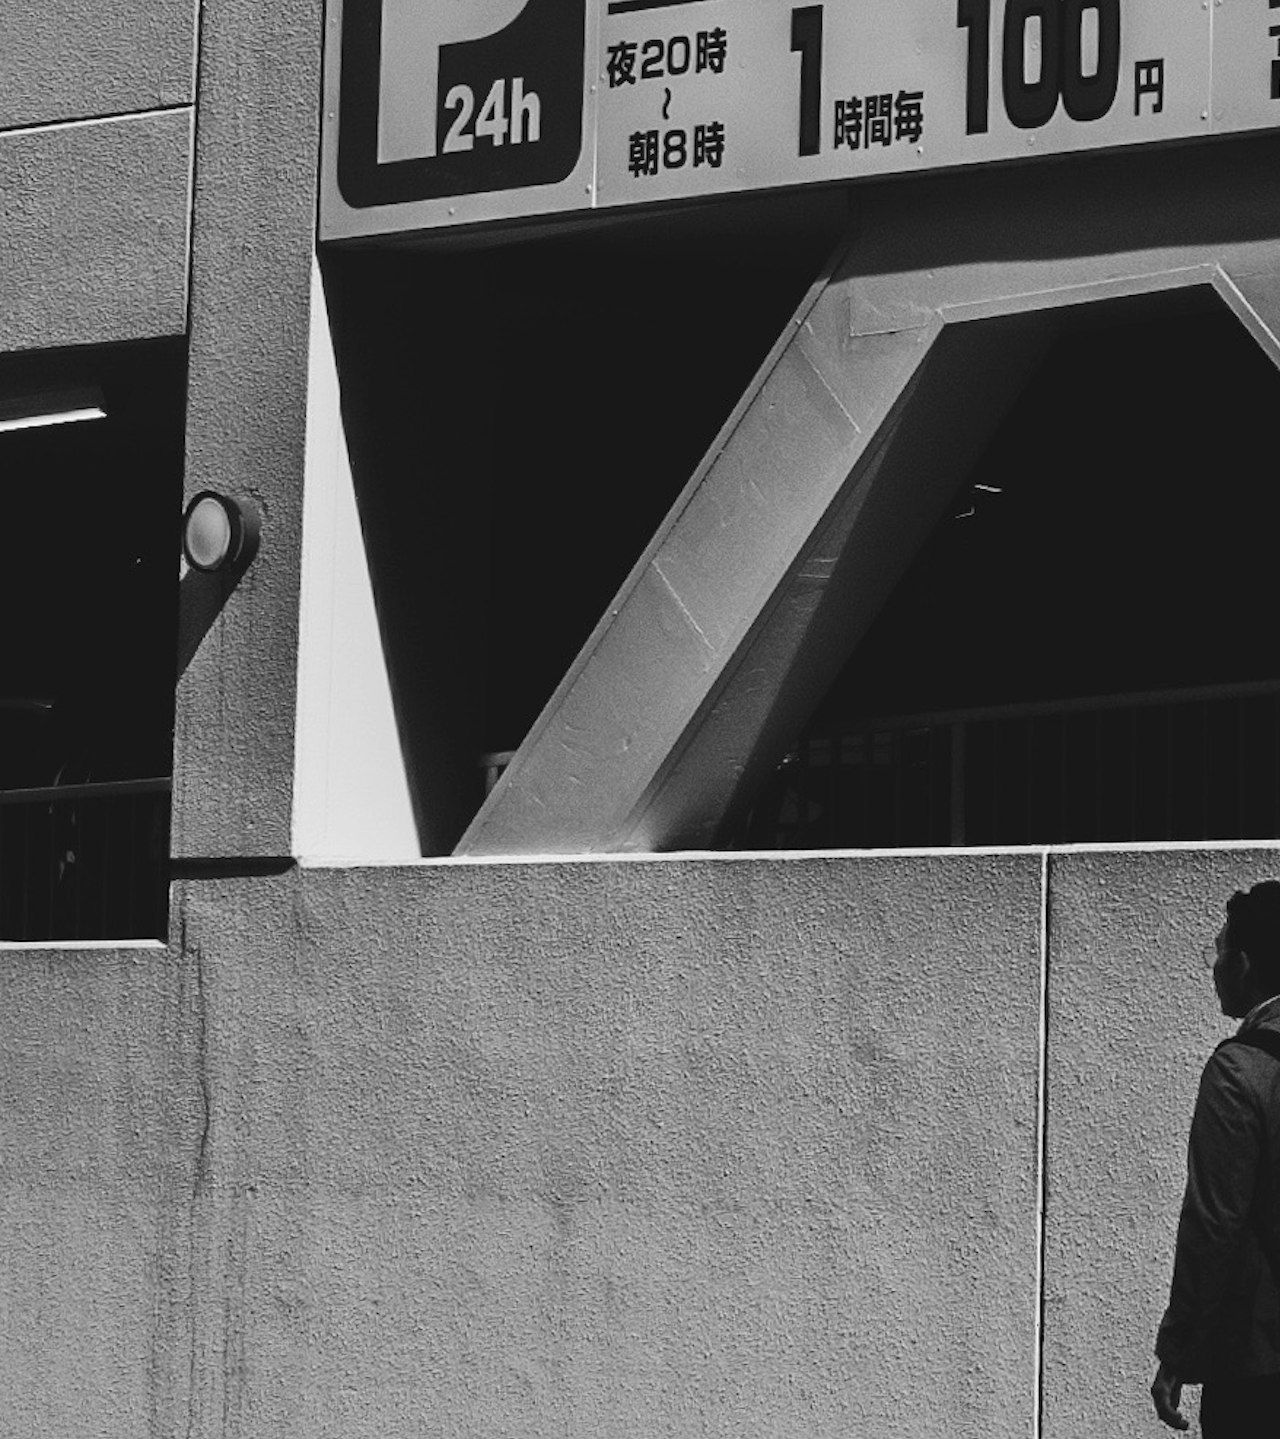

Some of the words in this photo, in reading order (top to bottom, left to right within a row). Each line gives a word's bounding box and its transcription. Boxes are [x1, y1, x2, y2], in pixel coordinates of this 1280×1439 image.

[605, 25, 728, 90] 夜20時
[441, 77, 542, 155] 24h
[627, 119, 726, 180] 朝8時
